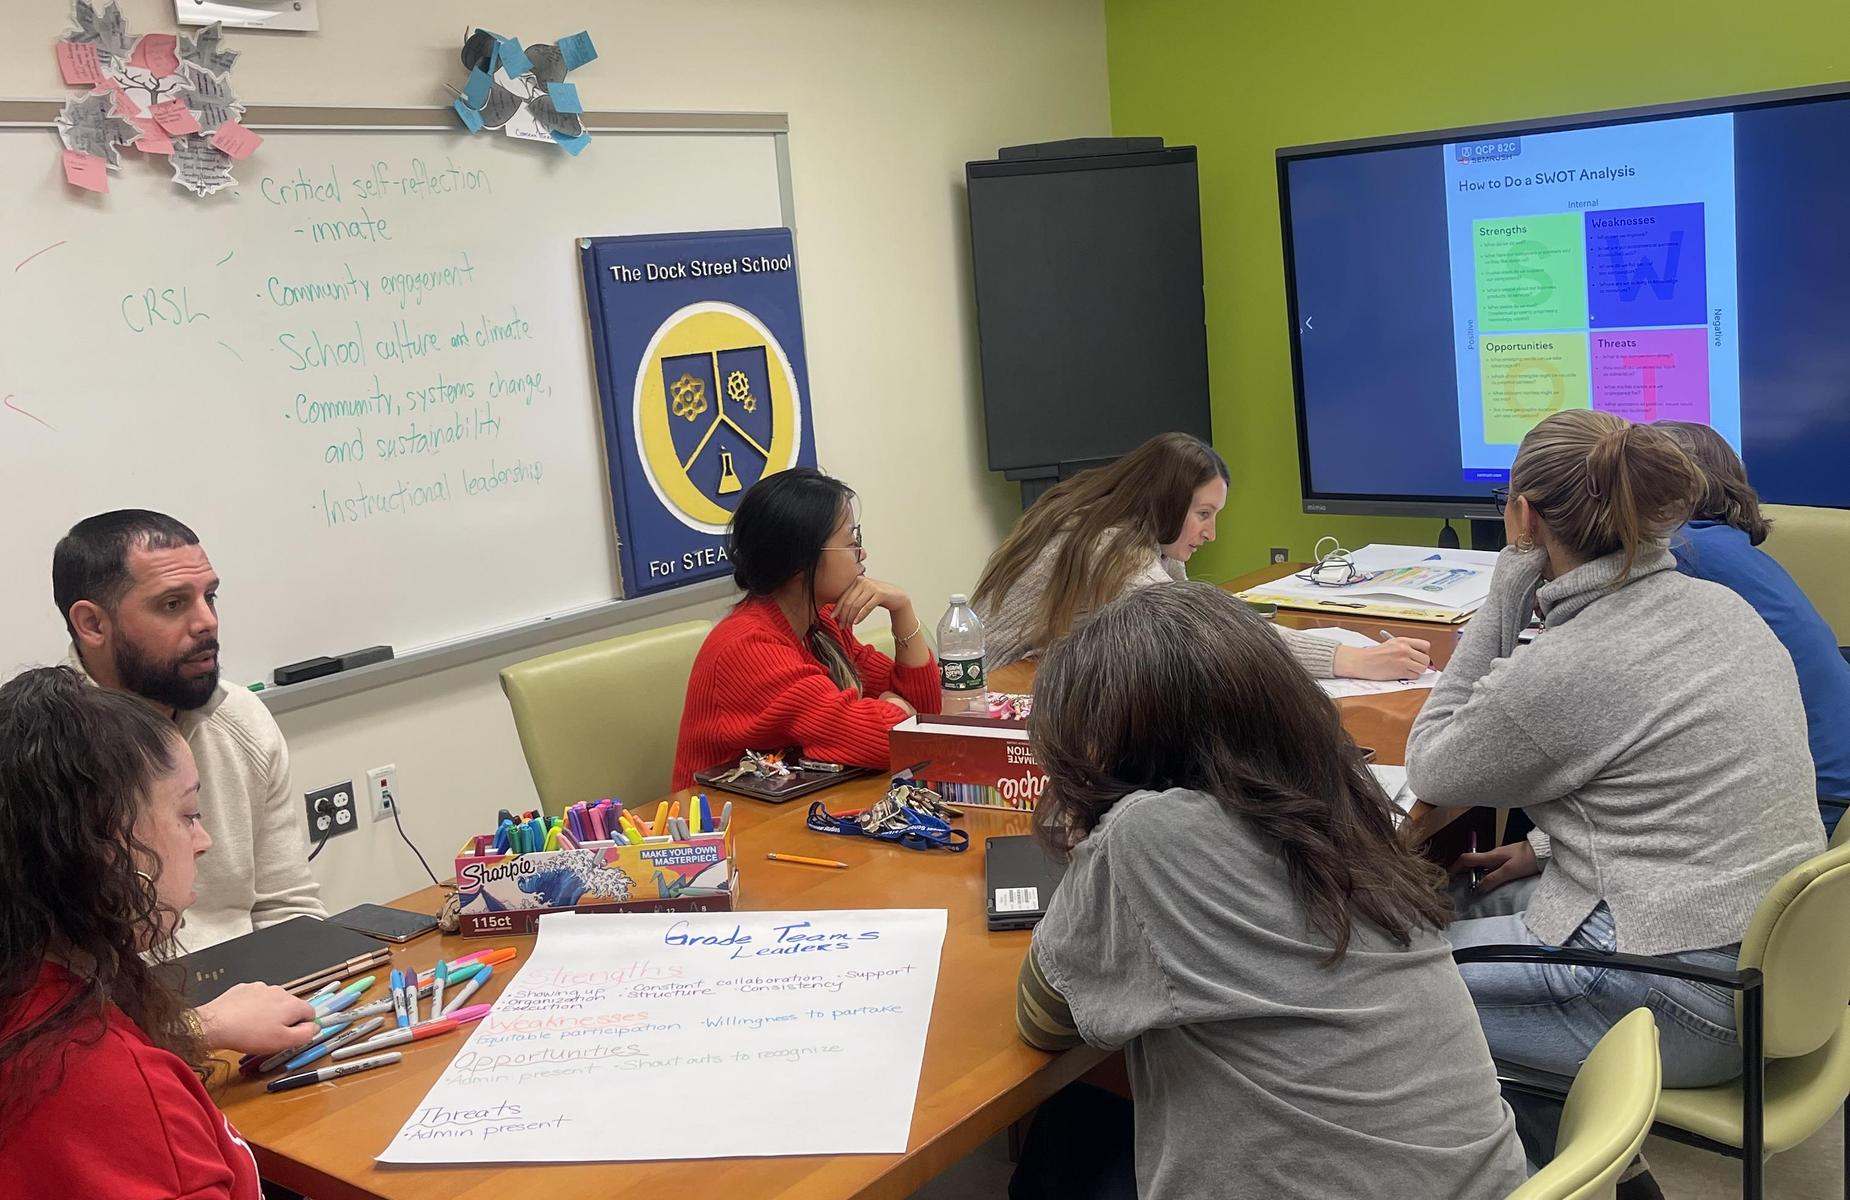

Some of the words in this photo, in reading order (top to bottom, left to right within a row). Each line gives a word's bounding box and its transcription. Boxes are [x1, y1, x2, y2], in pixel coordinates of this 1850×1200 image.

[1475, 144, 1495, 155] QCP
[1497, 142, 1516, 152] 82C
[260, 165, 341, 205] Critical
[352, 156, 493, 201] self-reflection
[1459, 180, 1486, 192] How
[1488, 179, 1501, 189] to
[1505, 176, 1522, 188] Do
[1525, 177, 1532, 186] a
[1535, 169, 1576, 185] SWOT
[1579, 165, 1636, 182] Analysis
[1568, 199, 1599, 209] Internal
[1479, 225, 1527, 237] Strengths
[1591, 216, 1656, 228] Weaknesses
[610, 264, 642, 282] The
[646, 260, 687, 281] Dock
[691, 257, 738, 277] Street
[742, 253, 792, 274] School
[267, 262, 370, 307] Community
[381, 252, 475, 310] engagement
[278, 320, 367, 371] School
[375, 319, 441, 364] culture
[450, 320, 471, 348] and
[475, 306, 533, 348] climate
[1467, 319, 1475, 350] Positive
[1712, 308, 1723, 347] Negative
[1485, 341, 1554, 352] Opportunities
[1597, 338, 1637, 348] Threats
[406, 373, 475, 413] systems
[324, 427, 364, 465] and
[377, 401, 501, 459] sustainability
[322, 472, 452, 528] Instructional
[649, 560, 676, 578] For
[683, 546, 737, 571] STEA
[1007, 755, 1038, 765] IMATE
[641, 849, 668, 859] MAKE
[669, 847, 694, 857] YOUR
[694, 846, 717, 854] OWN
[654, 854, 718, 866] MASTERPIECE
[460, 857, 536, 890] Sharpie
[471, 916, 512, 928] 115ct
[664, 920, 753, 947] Grade
[773, 921, 881, 944] Teams
[730, 942, 850, 960] Leaders
[524, 960, 684, 987] Strengths
[633, 980, 706, 992] Constant
[716, 973, 823, 987] collaboration
[846, 964, 916, 982] Support
[516, 987, 579, 1000] Showing
[584, 987, 607, 998] up
[627, 986, 716, 999] Structure
[740, 980, 843, 994] Consistency
[502, 1003, 584, 1012] Execution
[508, 993, 606, 1006] Organization
[489, 1010, 649, 1031] Weaknesses
[705, 1013, 798, 1029] Willingness
[805, 1009, 825, 1019] to
[832, 1003, 904, 1020] partake
[475, 1030, 552, 1047] Equitable
[560, 1023, 682, 1041] participation
[454, 1044, 643, 1077] Opportunities
[621, 1056, 682, 1072] Shout
[734, 1050, 750, 1061] to
[757, 1044, 845, 1061] recognize
[449, 1072, 510, 1087] Admin
[519, 1063, 602, 1085] present
[417, 1100, 522, 1124] Threats
[408, 1128, 474, 1141] Admin
[484, 1114, 574, 1141] present
